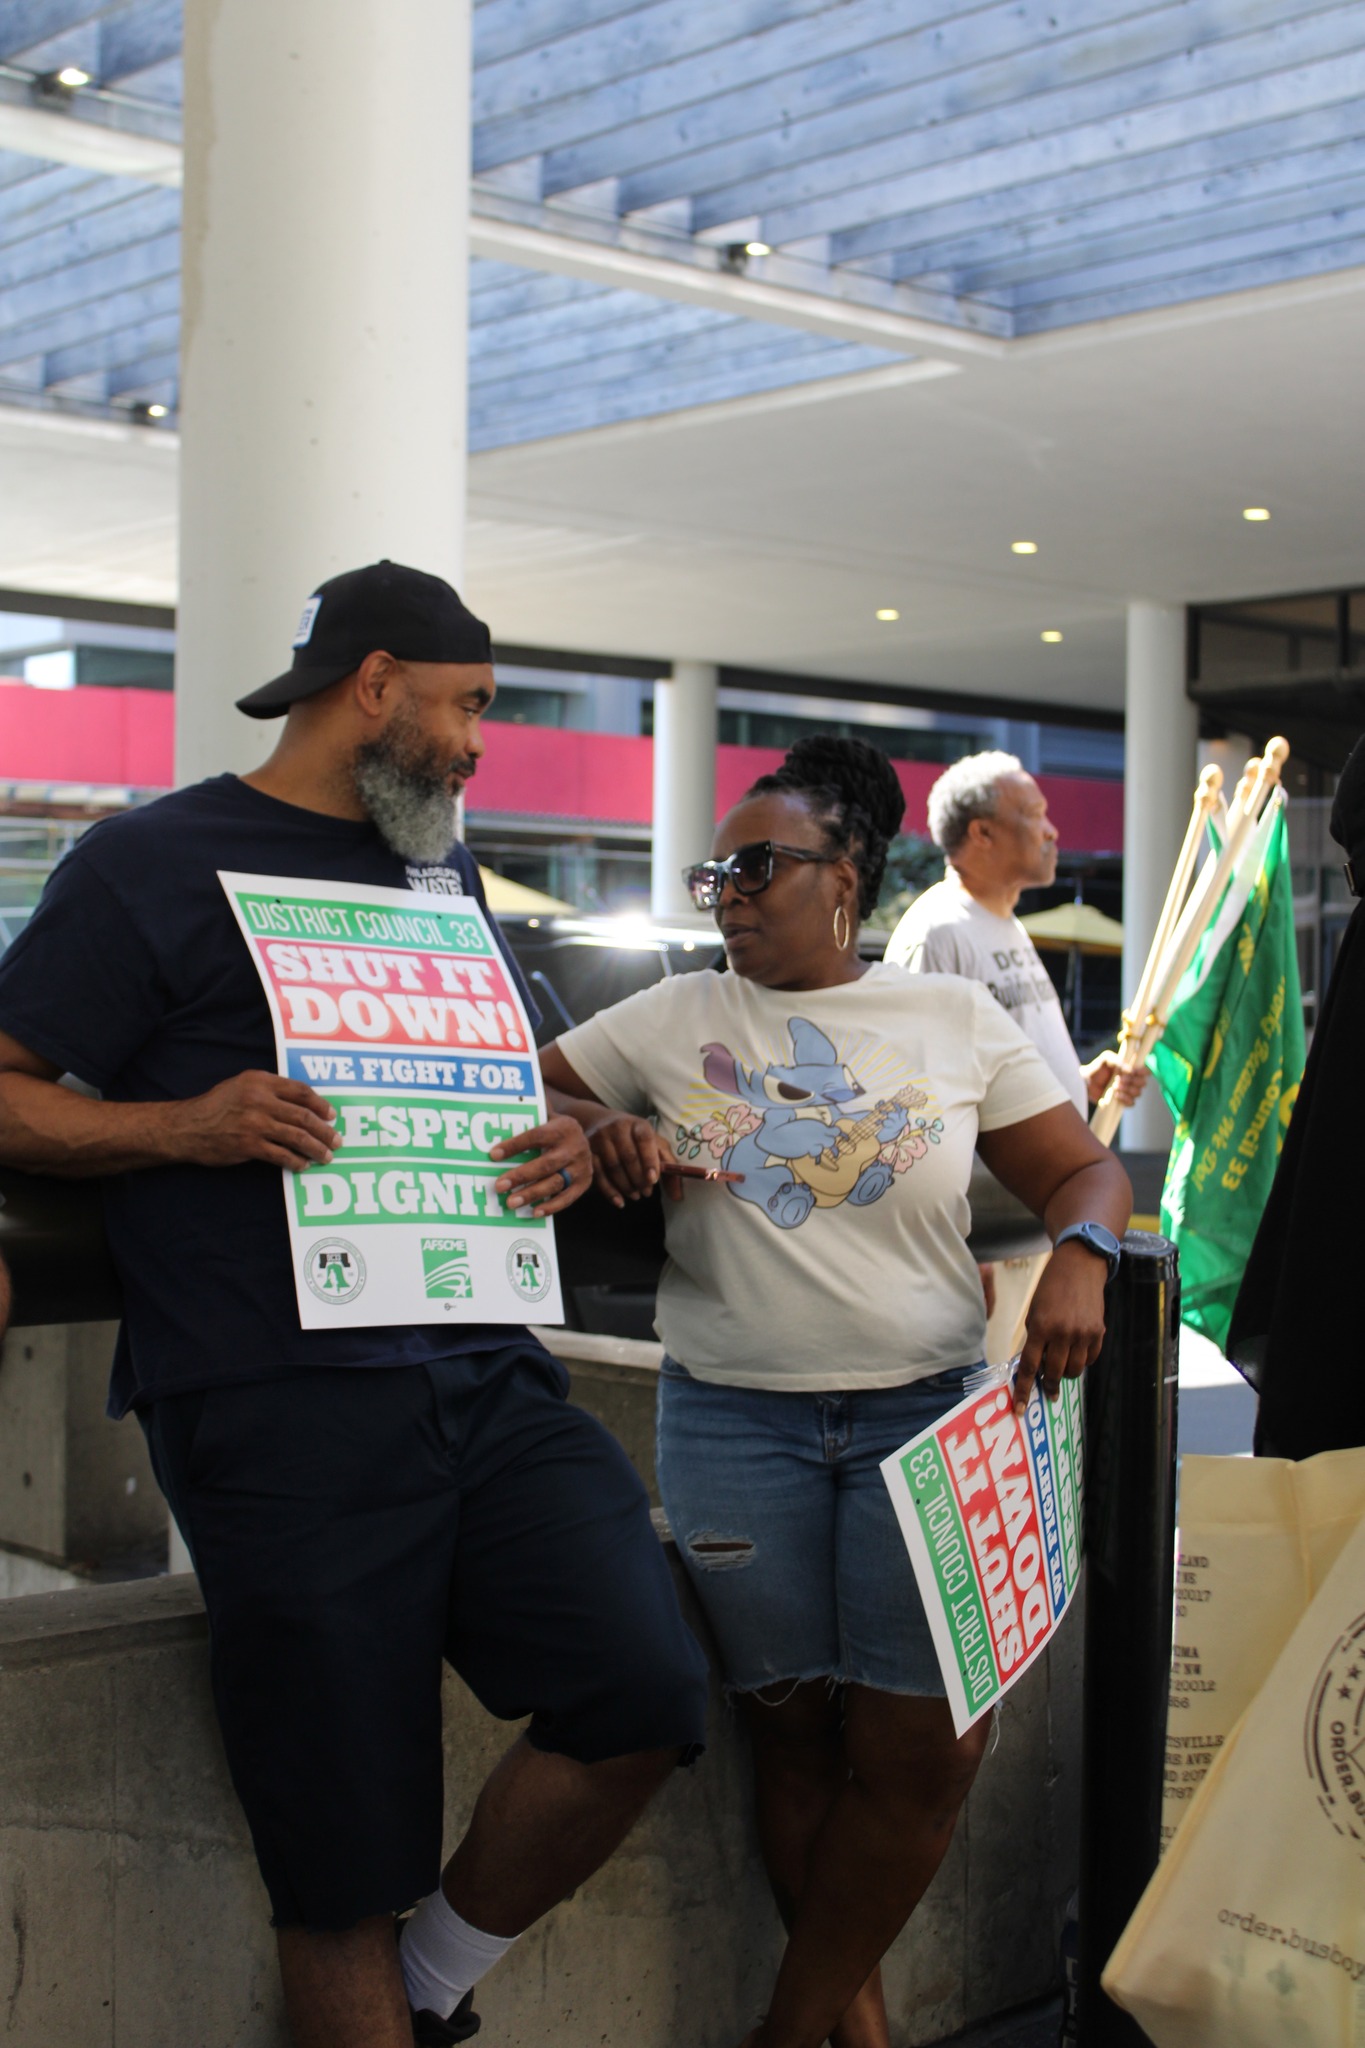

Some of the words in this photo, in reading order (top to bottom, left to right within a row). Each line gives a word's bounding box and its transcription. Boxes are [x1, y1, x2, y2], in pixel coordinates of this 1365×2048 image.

[245, 899, 352, 939] DISTRICT
[357, 912, 452, 948] COUNCIL
[450, 920, 484, 950] 33
[266, 942, 424, 992] SHUT
[431, 959, 495, 996] IT
[279, 985, 524, 1050] DOWN!
[301, 1055, 355, 1082] WE
[361, 1057, 457, 1088] FIGHT
[462, 1064, 525, 1092] FOR
[327, 1105, 535, 1154] ESPECT
[1221, 1156, 1249, 1192] 33
[422, 1239, 466, 1252] AFSCME
[910, 1446, 939, 1489] 33
[945, 1427, 992, 1507] IT
[1051, 1380, 1079, 1586] RESPEC
[974, 1388, 1049, 1649] DOWN!
[1036, 1451, 1060, 1555] FIGHT
[924, 1487, 966, 1596] COUNCIL
[968, 1509, 1024, 1673] SHUT
[1050, 1548, 1063, 1607] WE
[951, 1600, 994, 1706] DISTRICT
[1166, 1735, 1224, 1748] TSVILLE
[1182, 1769, 1207, 1782] 207
[1329, 1721, 1365, 1826] ORDER.BU
